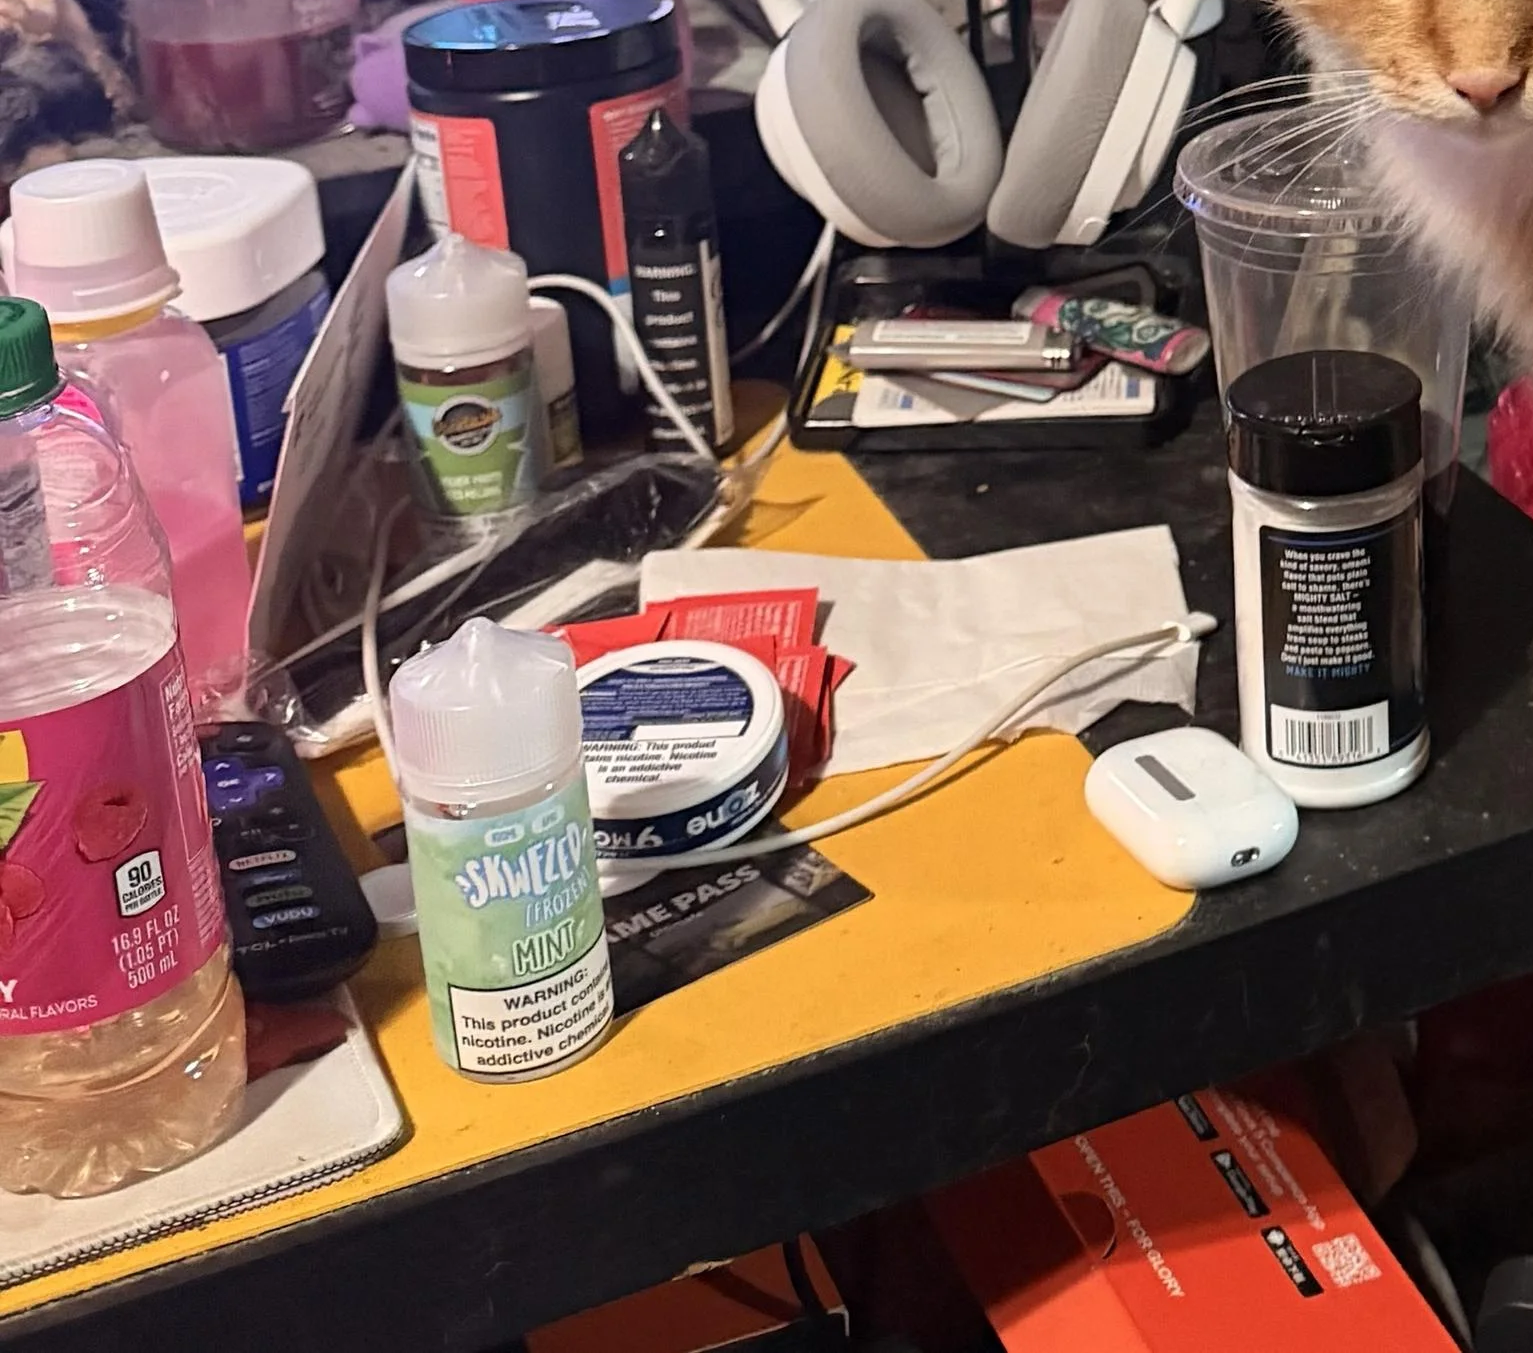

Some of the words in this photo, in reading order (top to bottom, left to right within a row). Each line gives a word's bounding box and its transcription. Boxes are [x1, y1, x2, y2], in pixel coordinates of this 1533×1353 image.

[1284, 549, 1308, 560] When
[1310, 553, 1326, 562] you
[1327, 551, 1351, 561] crave
[1352, 548, 1365, 558] the
[1280, 558, 1297, 570] kind
[1299, 563, 1308, 571] of
[1284, 570, 1307, 581] flavor
[1308, 573, 1325, 582] that
[1326, 573, 1345, 582] puts
[1347, 568, 1368, 580] plain
[1282, 581, 1297, 591] salt
[1298, 583, 1307, 592] to
[1342, 579, 1370, 591] there's
[1294, 593, 1327, 603] MIGHTY
[1330, 591, 1351, 603] SALT
[1292, 603, 1297, 612] a
[1299, 602, 1361, 613] mouthwatering
[1297, 615, 1312, 623] salt
[1314, 615, 1338, 624] blend
[1340, 612, 1356, 623] that
[1288, 624, 1324, 634] amplifies
[1325, 621, 1368, 634] everything
[1287, 633, 1306, 644] from
[1308, 636, 1329, 645] soup
[1330, 635, 1339, 644] to
[1341, 631, 1368, 644] steaks
[1281, 651, 1302, 664] Don't
[1303, 656, 1319, 666] just
[1320, 656, 1343, 665] make
[1345, 655, 1351, 663] it
[1284, 643, 1299, 653] and
[1300, 647, 1323, 656] pasta
[1325, 647, 1333, 655] to
[1286, 664, 1313, 677] MAKE
[1318, 667, 1327, 679] IT
[1332, 663, 1370, 678] MIGHTY
[646, 741, 669, 751] This
[672, 739, 717, 752] product
[615, 752, 666, 762] nicotine.
[669, 750, 718, 761] Nicotine
[598, 764, 608, 773] is
[611, 764, 626, 772] an
[629, 763, 682, 772] addictive
[687, 779, 760, 836] zone
[235, 851, 289, 868] NETFLIX
[128, 860, 152, 889] 90
[122, 875, 163, 904] CALORIES
[671, 862, 762, 914] PASS
[125, 900, 139, 913] PER
[139, 887, 163, 906] BOTTLE
[265, 905, 315, 924] VUDU
[111, 926, 142, 955] 16.9
[146, 917, 161, 939] FL
[164, 903, 181, 927] OZ
[119, 942, 154, 974] (1.05
[158, 927, 180, 952] PT)
[512, 917, 576, 977] MINT
[128, 965, 155, 990] 500
[160, 950, 179, 975] mL
[503, 967, 590, 1012] WARNING:
[30, 994, 98, 1020] FLAVORS
[461, 1014, 496, 1031] This
[501, 1001, 568, 1032] product
[461, 1035, 533, 1049] nicotine.
[537, 1001, 596, 1041] Nicotine
[477, 1045, 554, 1067] addictive
[1126, 1218, 1153, 1250] FOR
[1146, 1249, 1187, 1298] GLORY
